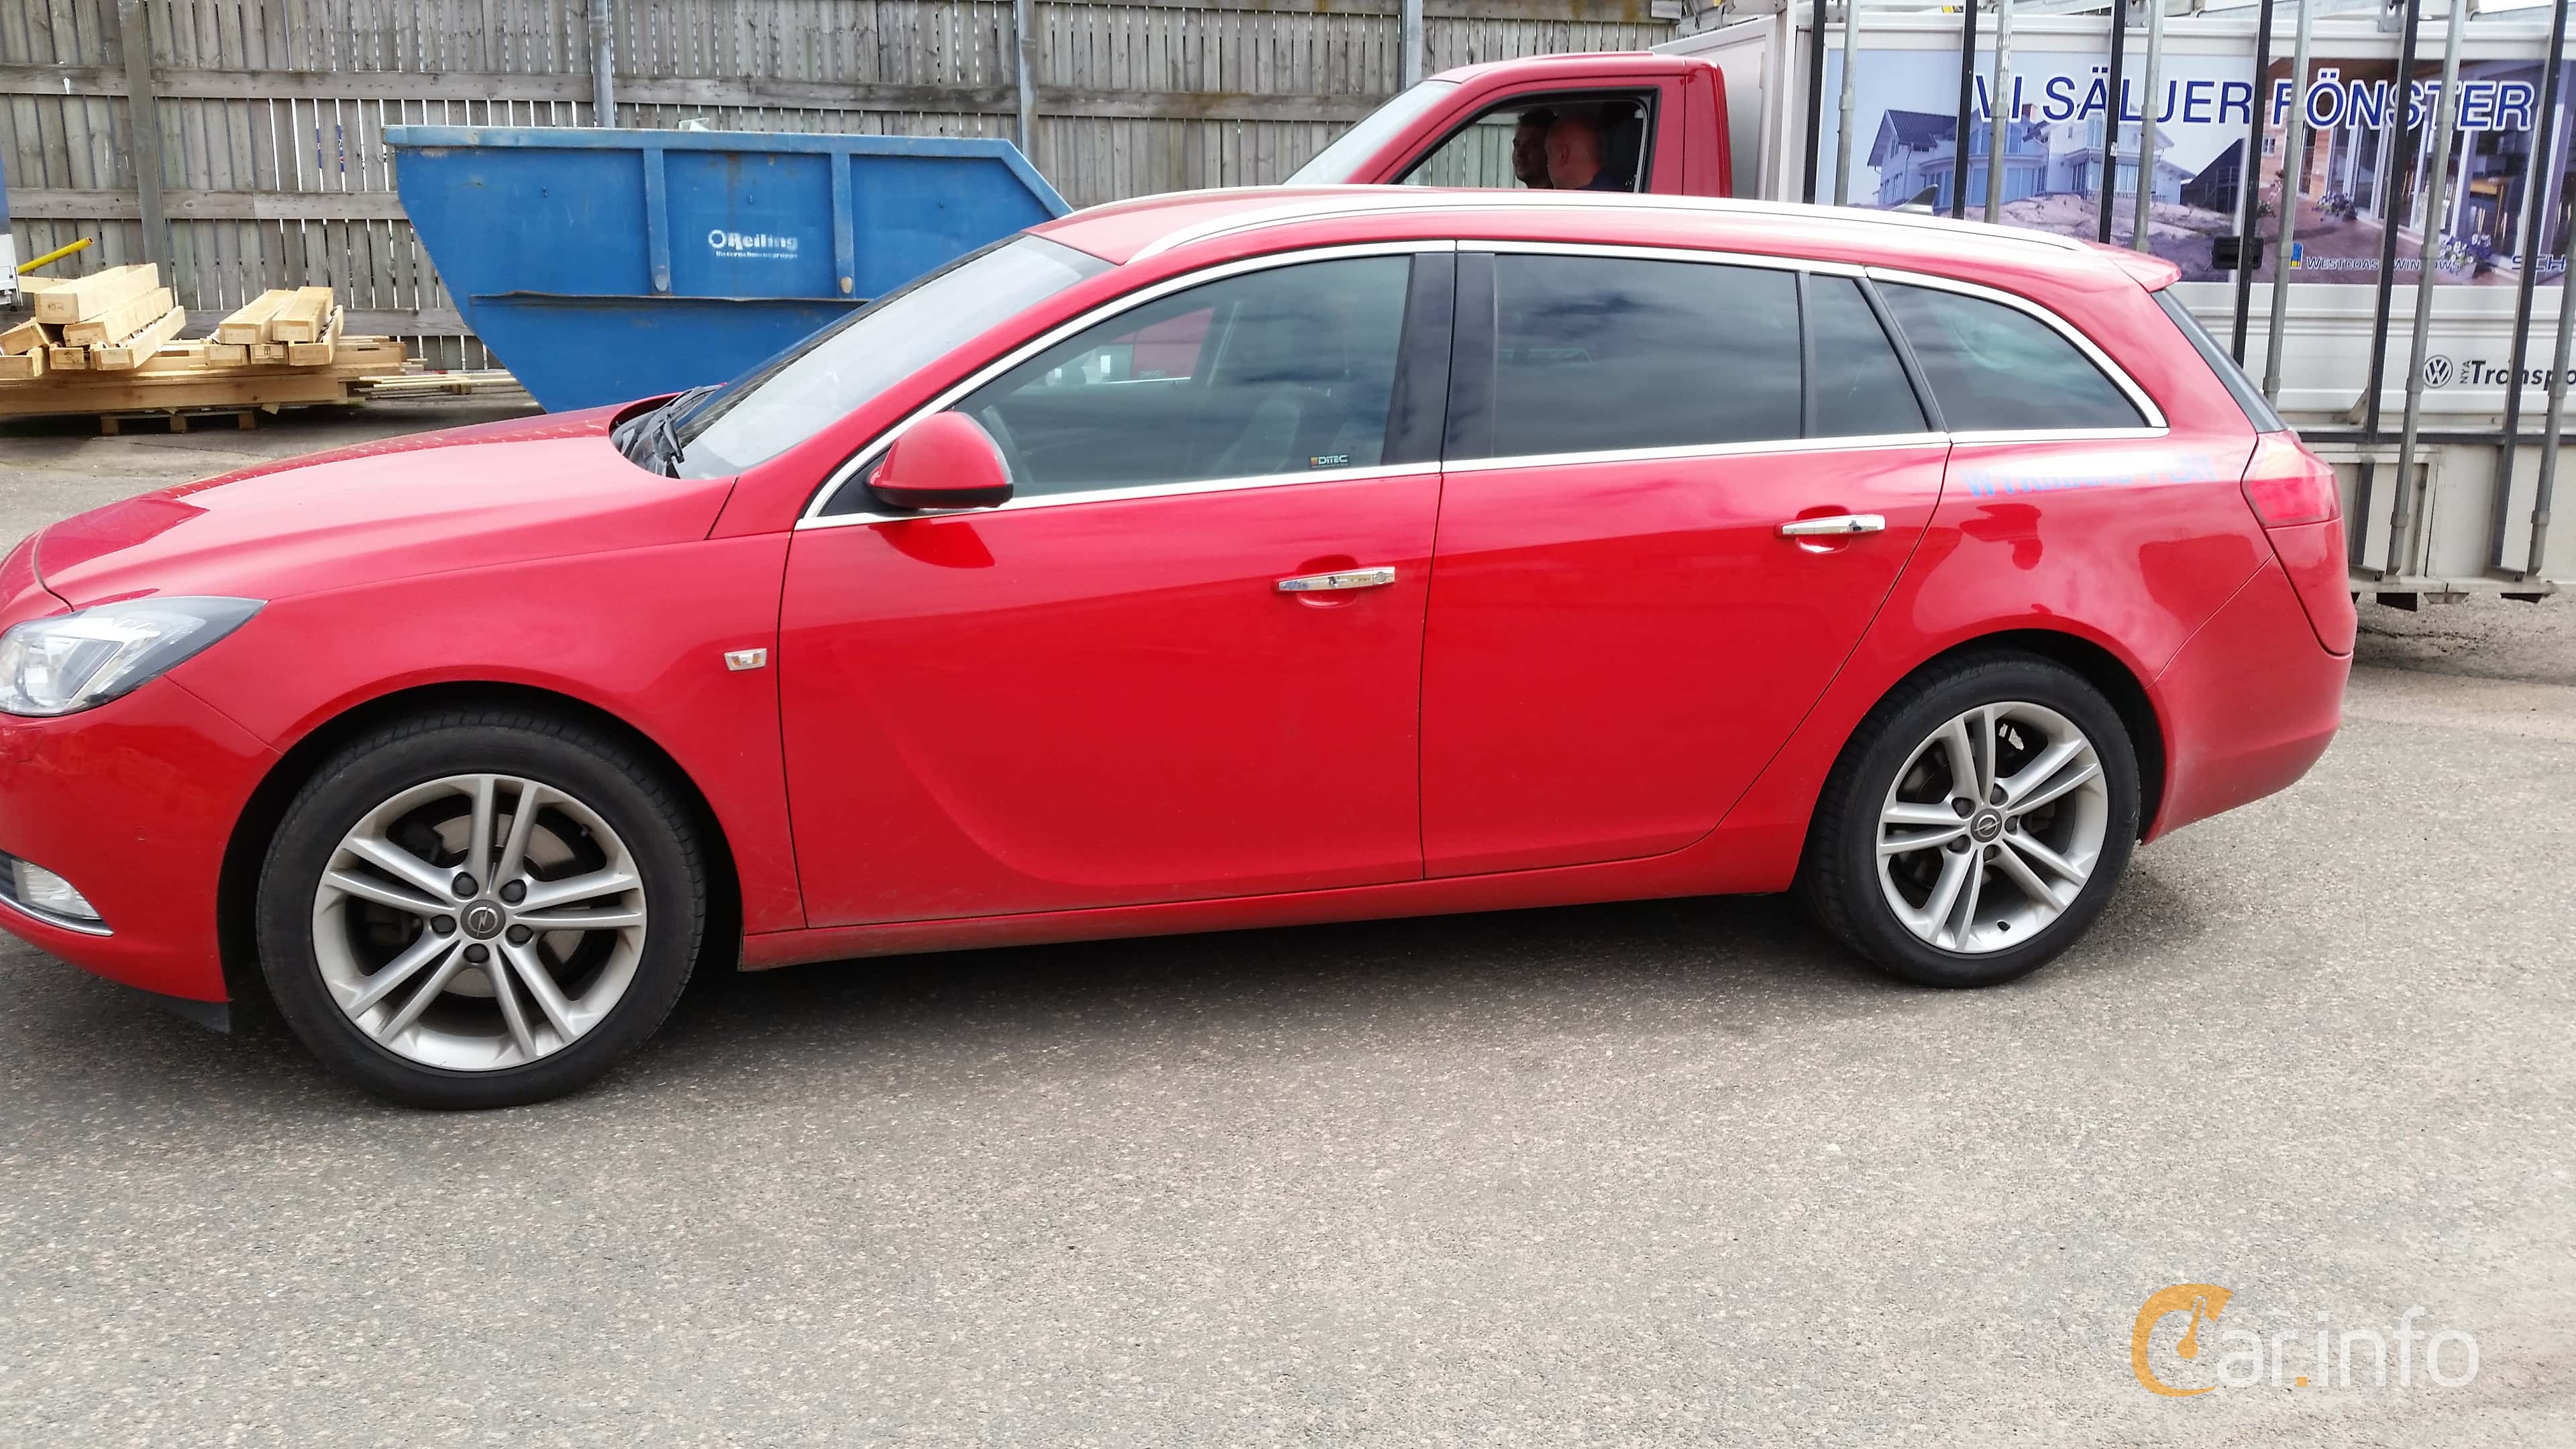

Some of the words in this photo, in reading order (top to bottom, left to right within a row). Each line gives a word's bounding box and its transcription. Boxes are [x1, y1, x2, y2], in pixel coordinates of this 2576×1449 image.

[2043, 66, 2254, 125] SÄLJER
[728, 232, 798, 251] Reiling
[2306, 256, 2380, 270] WESTCOAS
